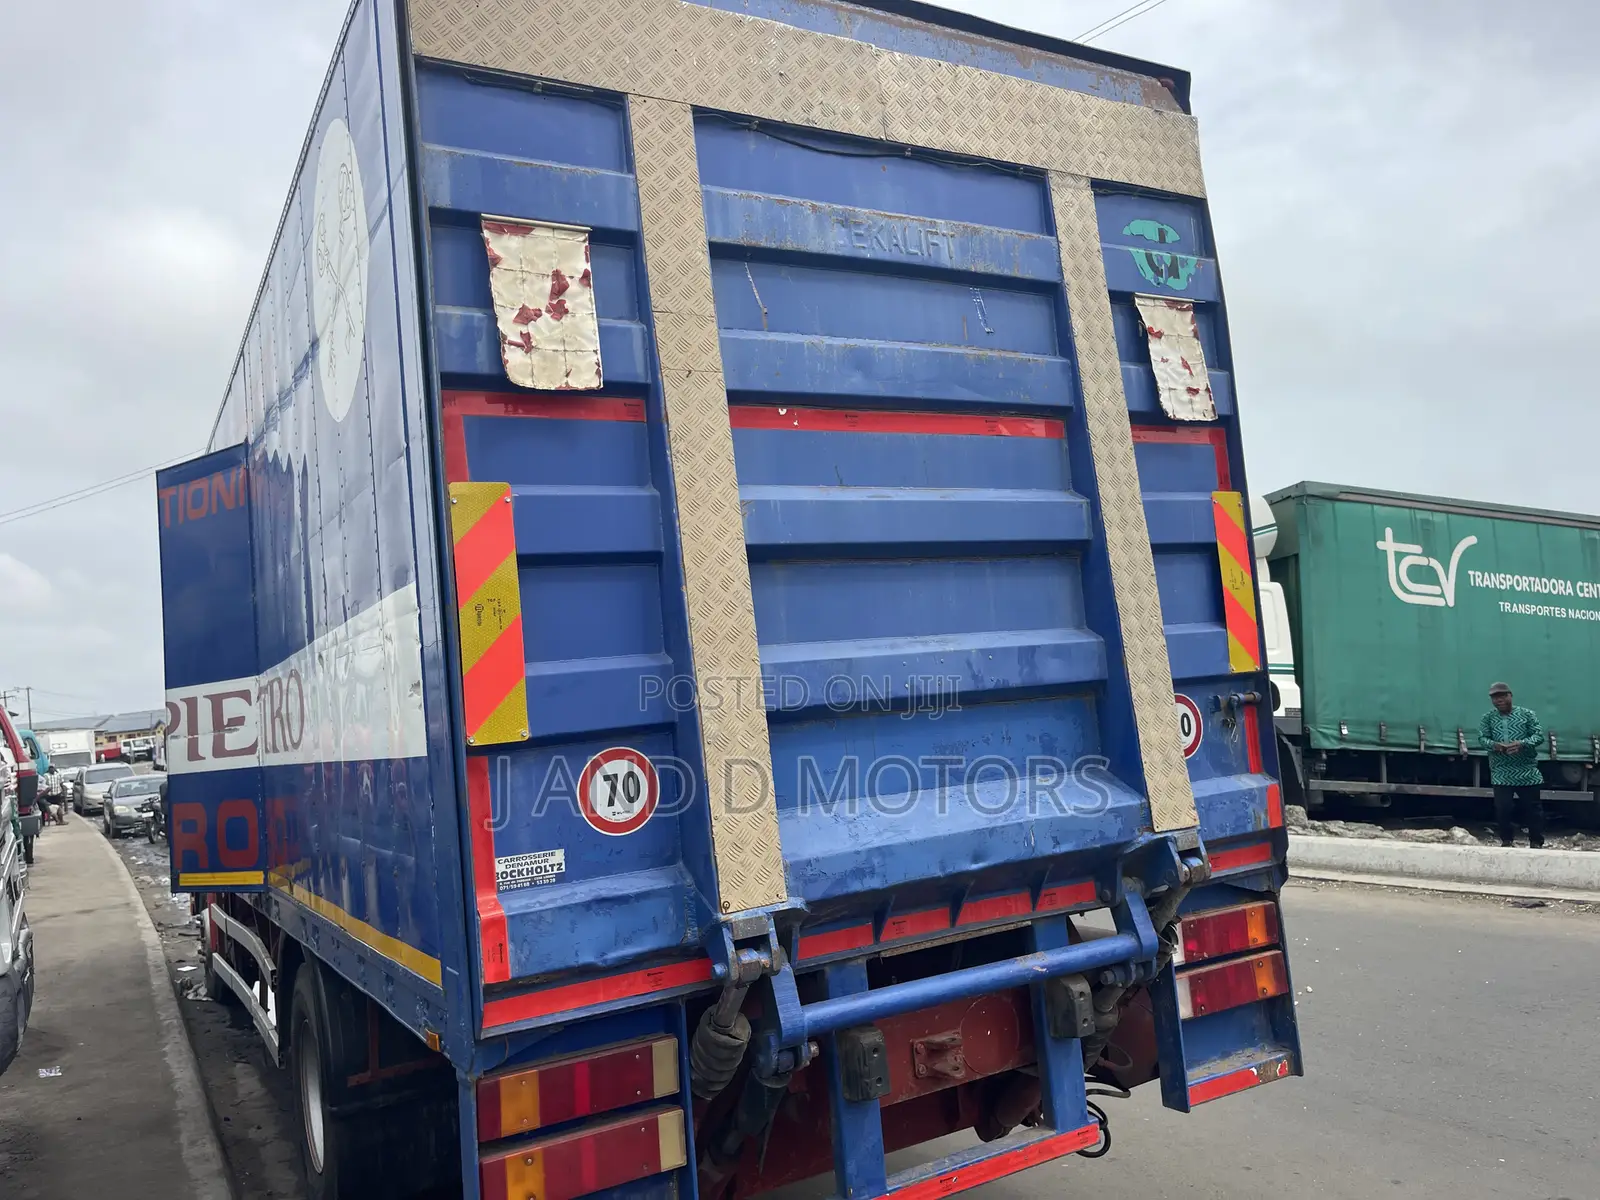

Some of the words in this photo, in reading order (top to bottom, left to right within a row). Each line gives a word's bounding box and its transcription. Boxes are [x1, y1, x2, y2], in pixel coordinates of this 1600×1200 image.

[1468, 570, 1574, 596] TRANSPORTADORA
[1499, 601, 1567, 618] TRANSPORTES
[602, 770, 641, 808] 70
[497, 851, 556, 865] CARROSSERIE
[505, 858, 550, 870] DENAMUR
